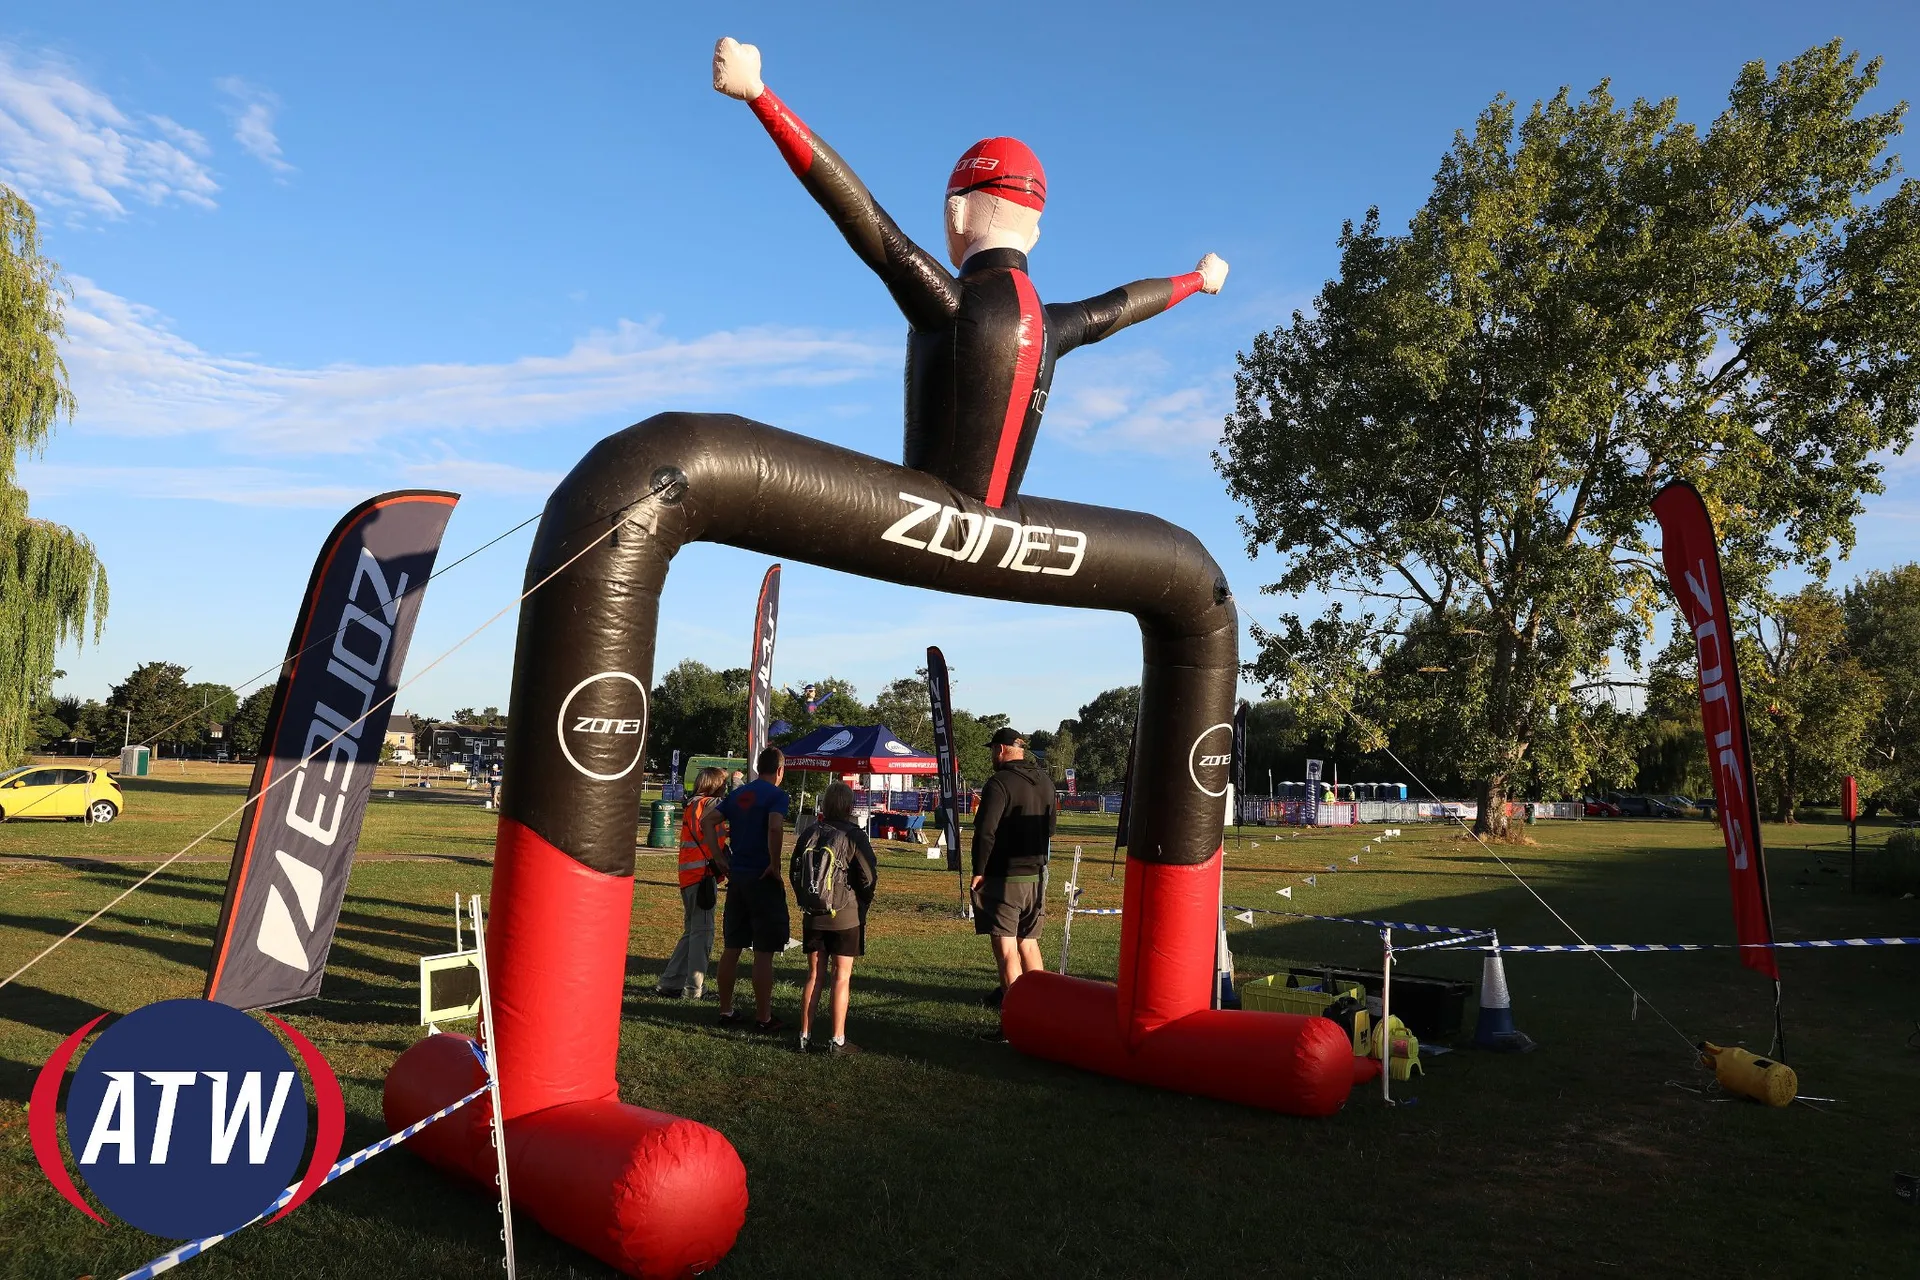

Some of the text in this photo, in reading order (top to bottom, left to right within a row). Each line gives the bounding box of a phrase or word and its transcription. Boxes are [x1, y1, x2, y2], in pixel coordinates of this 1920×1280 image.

[953, 157, 999, 172] ONE3
[881, 491, 1087, 577] ZONE3
[286, 546, 409, 846] ZONE3
[573, 716, 641, 734] ZONE3
[930, 677, 952, 799] ZONE3
